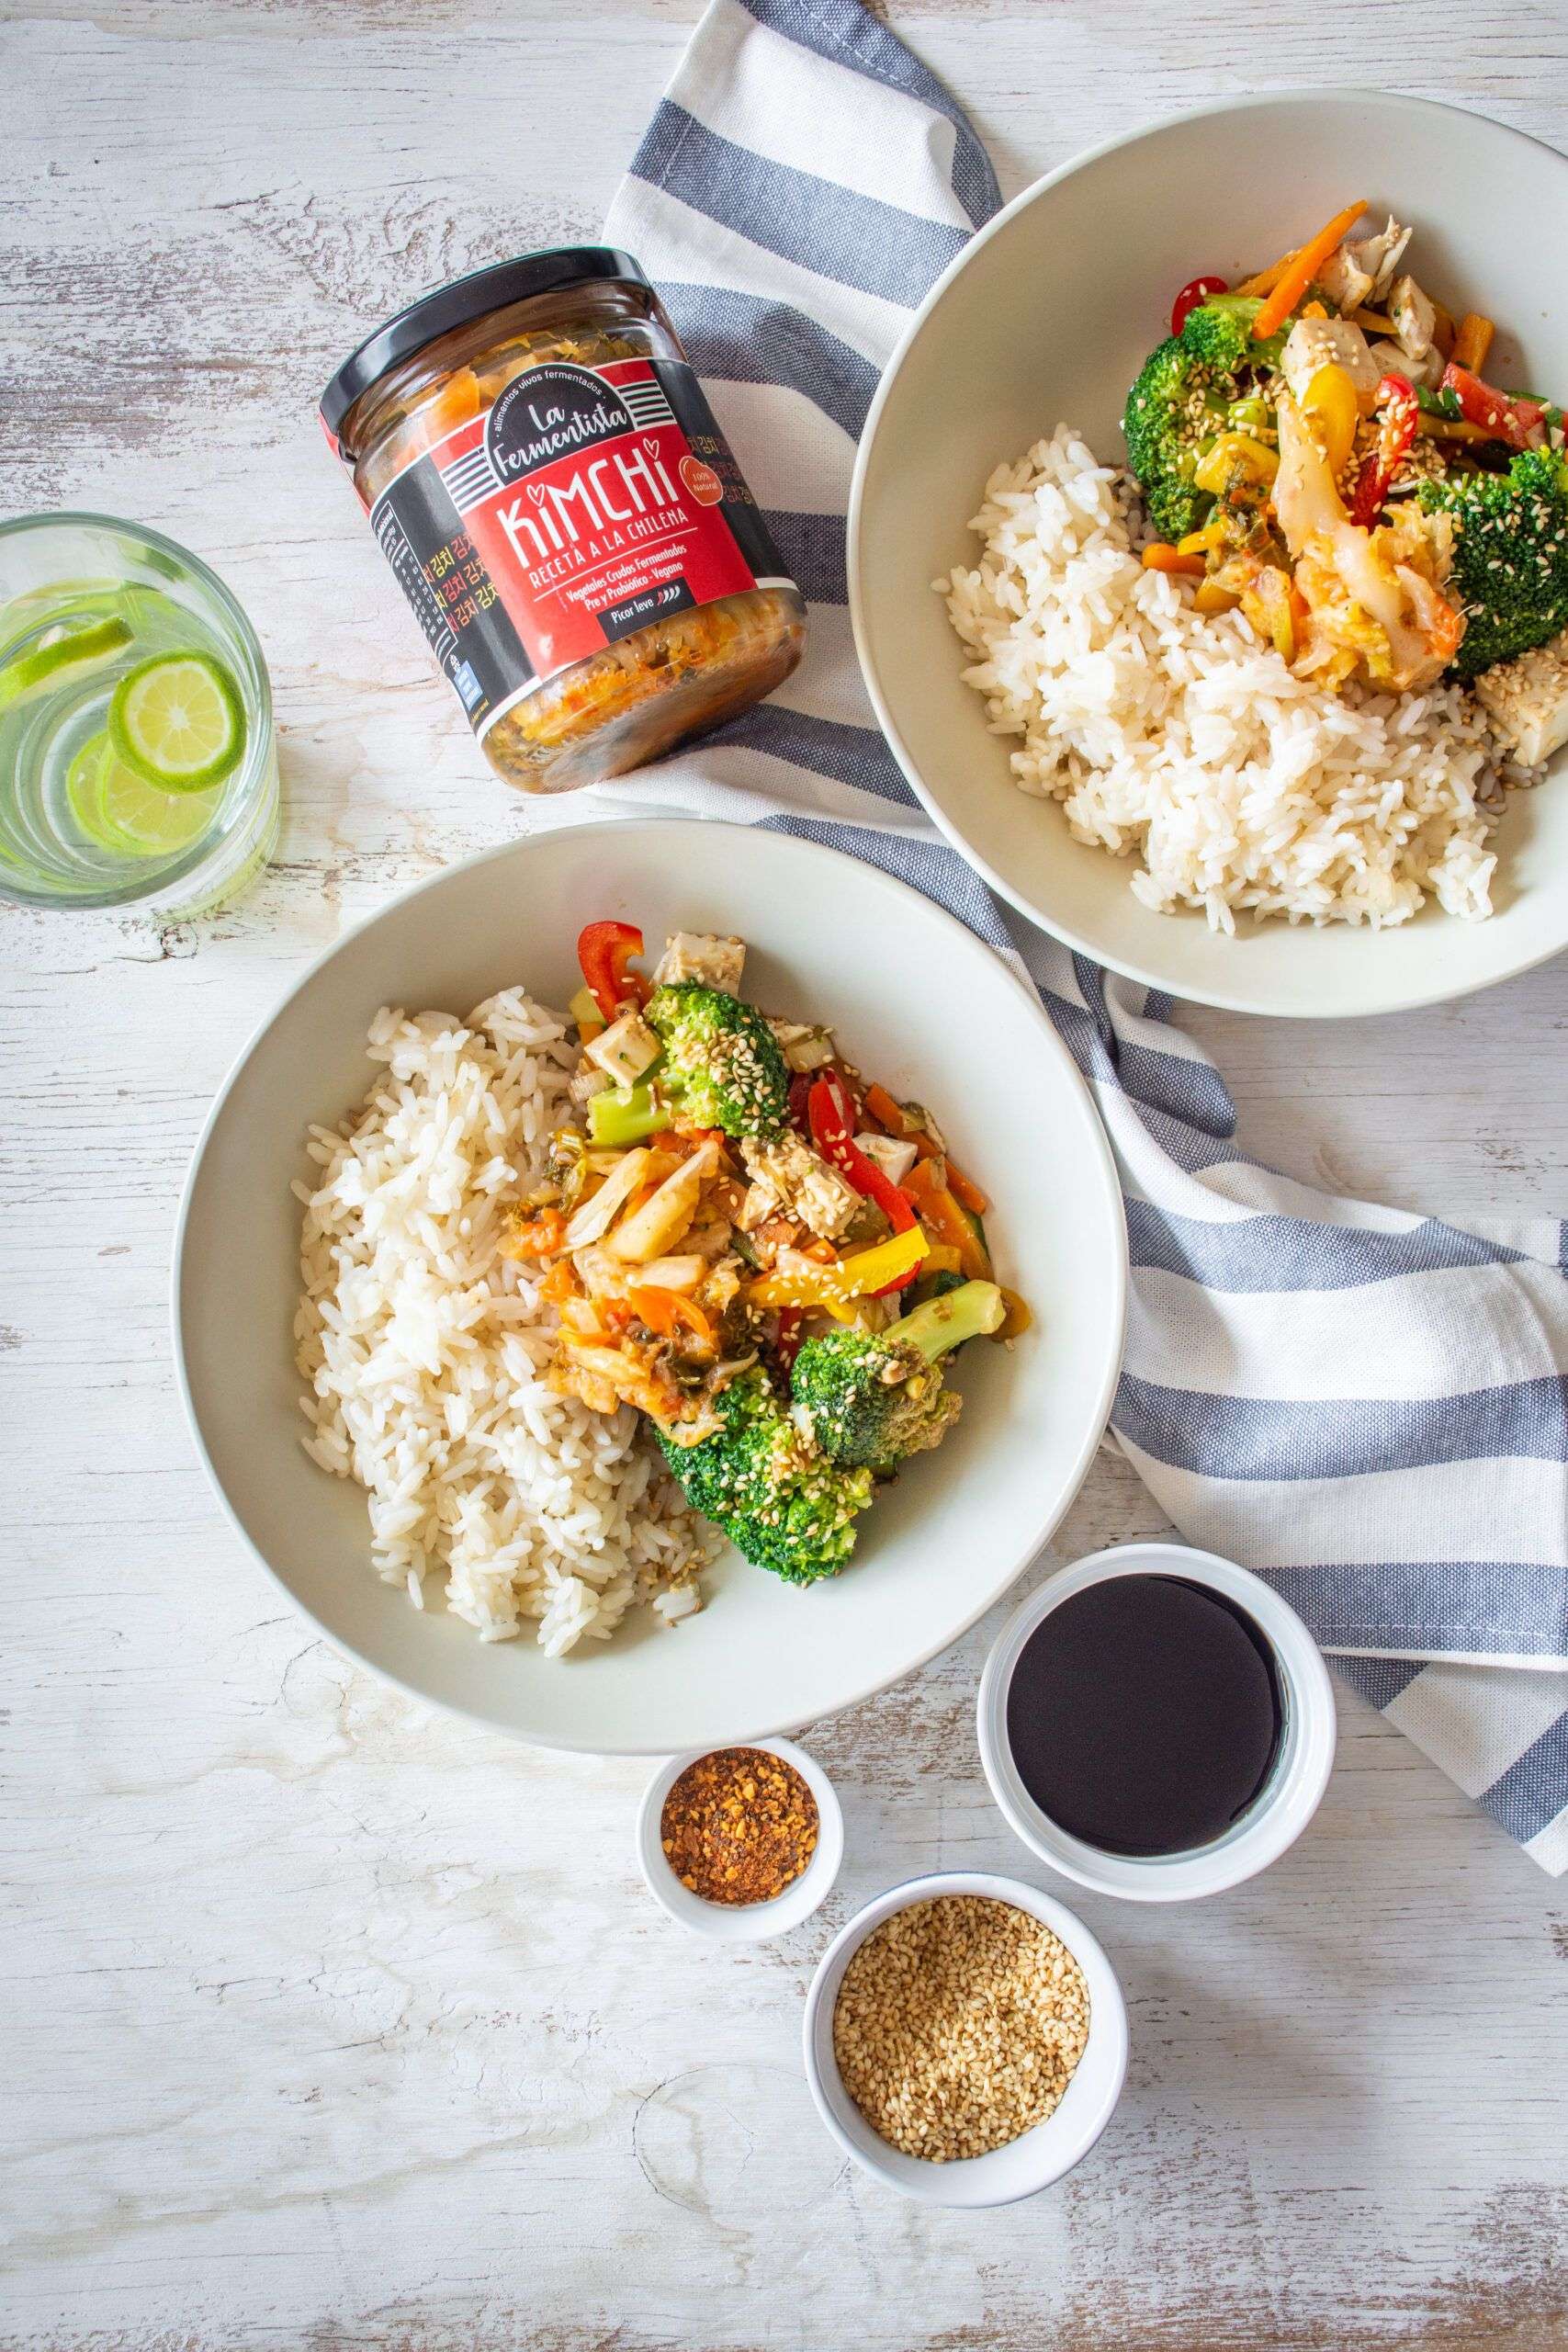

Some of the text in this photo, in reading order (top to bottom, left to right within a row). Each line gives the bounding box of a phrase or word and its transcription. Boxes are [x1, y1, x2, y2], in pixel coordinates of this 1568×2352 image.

[494, 369, 603, 432] alimentos vivos fermentados
[528, 404, 565, 432] La
[492, 402, 627, 477] Fermentista
[692, 481, 718, 492] Natural
[430, 546, 456, 579] 김치
[529, 507, 689, 589] RECETA A LA CHILENA
[442, 571, 468, 603] 김치
[566, 543, 688, 603] Vegetales Crudos Fermentados
[583, 598, 602, 611] Pre
[600, 594, 608, 606] y
[606, 575, 649, 600] Probiótico
[651, 562, 683, 579] Vegano
[454, 595, 479, 628] 김치
[611, 597, 655, 624] Picor leve
